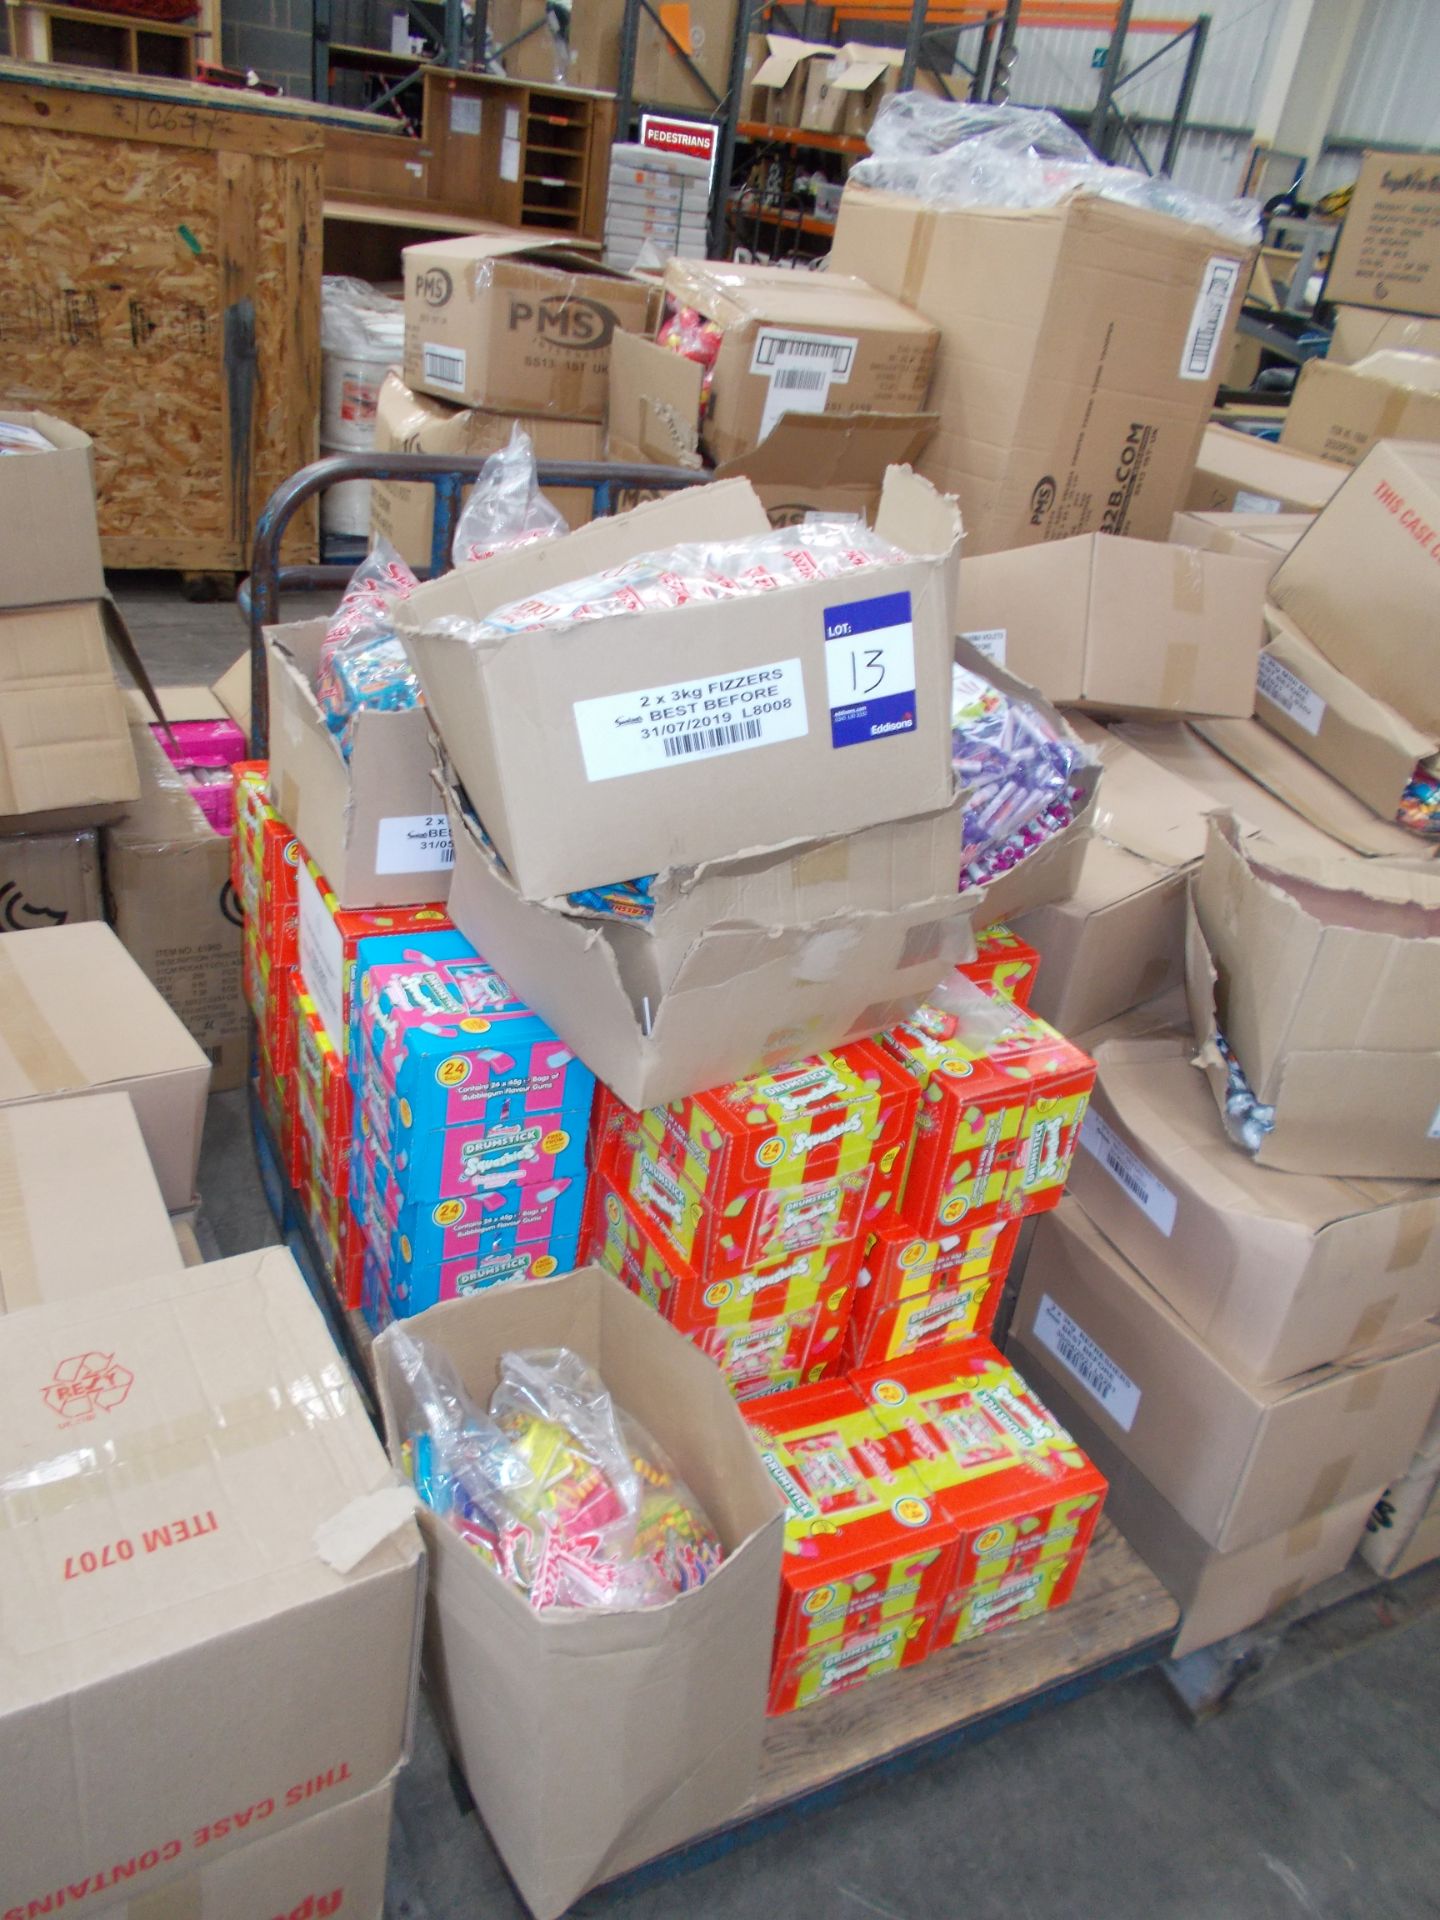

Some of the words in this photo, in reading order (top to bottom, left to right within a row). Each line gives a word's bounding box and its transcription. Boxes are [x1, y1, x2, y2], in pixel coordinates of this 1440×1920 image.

[648, 129, 711, 149] PEDESTRIANS
[415, 274, 443, 300] PMS
[509, 301, 594, 340] PMS
[1031, 487, 1051, 526] PMS
[1373, 480, 1405, 513] THIS
[1398, 509, 1437, 548] CASE
[828, 622, 852, 638] LOT:
[851, 649, 886, 694] 13
[640, 696, 650, 708] 2
[656, 695, 666, 704] x
[671, 688, 704, 702] 3kg
[708, 668, 784, 694] FIZZERS
[649, 702, 699, 723] BEST
[703, 685, 779, 711] BEFORE
[640, 712, 732, 740] 31/07/2019
[742, 698, 793, 718] L8008
[870, 718, 913, 736] Eddisons
[425, 817, 434, 827] 2
[437, 818, 445, 826] x
[444, 1062, 465, 1075] 24
[765, 1067, 831, 1096] DRUMSTICK
[458, 1083, 489, 1094] Contains
[532, 1075, 550, 1083] Bags
[462, 1089, 503, 1101] Bubblegum
[532, 1082, 554, 1090] Gums
[466, 1130, 536, 1154] DRUMSTICK
[763, 1142, 780, 1157] 24
[1026, 1122, 1045, 1185] DRUMSTICK
[439, 1203, 460, 1216] 24
[785, 1189, 838, 1211] DRUMSTICK
[903, 1245, 923, 1261] 24
[461, 1256, 527, 1283] DRUMSTICK
[710, 1284, 728, 1299] 24
[910, 1293, 968, 1323] DRUMSTICK
[733, 1324, 787, 1346] DRUMSTICK
[980, 1391, 1034, 1446] DRUMSTICK
[763, 1452, 812, 1513] DRUMSTICK
[902, 1501, 924, 1520] 24
[142, 1510, 219, 1553] ITEM
[981, 1532, 1000, 1548] 24
[64, 1538, 135, 1581] 0707
[811, 1591, 830, 1609] 24
[977, 1576, 1040, 1608] DRUMSTICK
[824, 1632, 894, 1667] DRUMSTICK
[284, 1761, 353, 1808] THIS
[192, 1797, 276, 1849] CASE
[3, 1840, 183, 1920] CONTAINS
